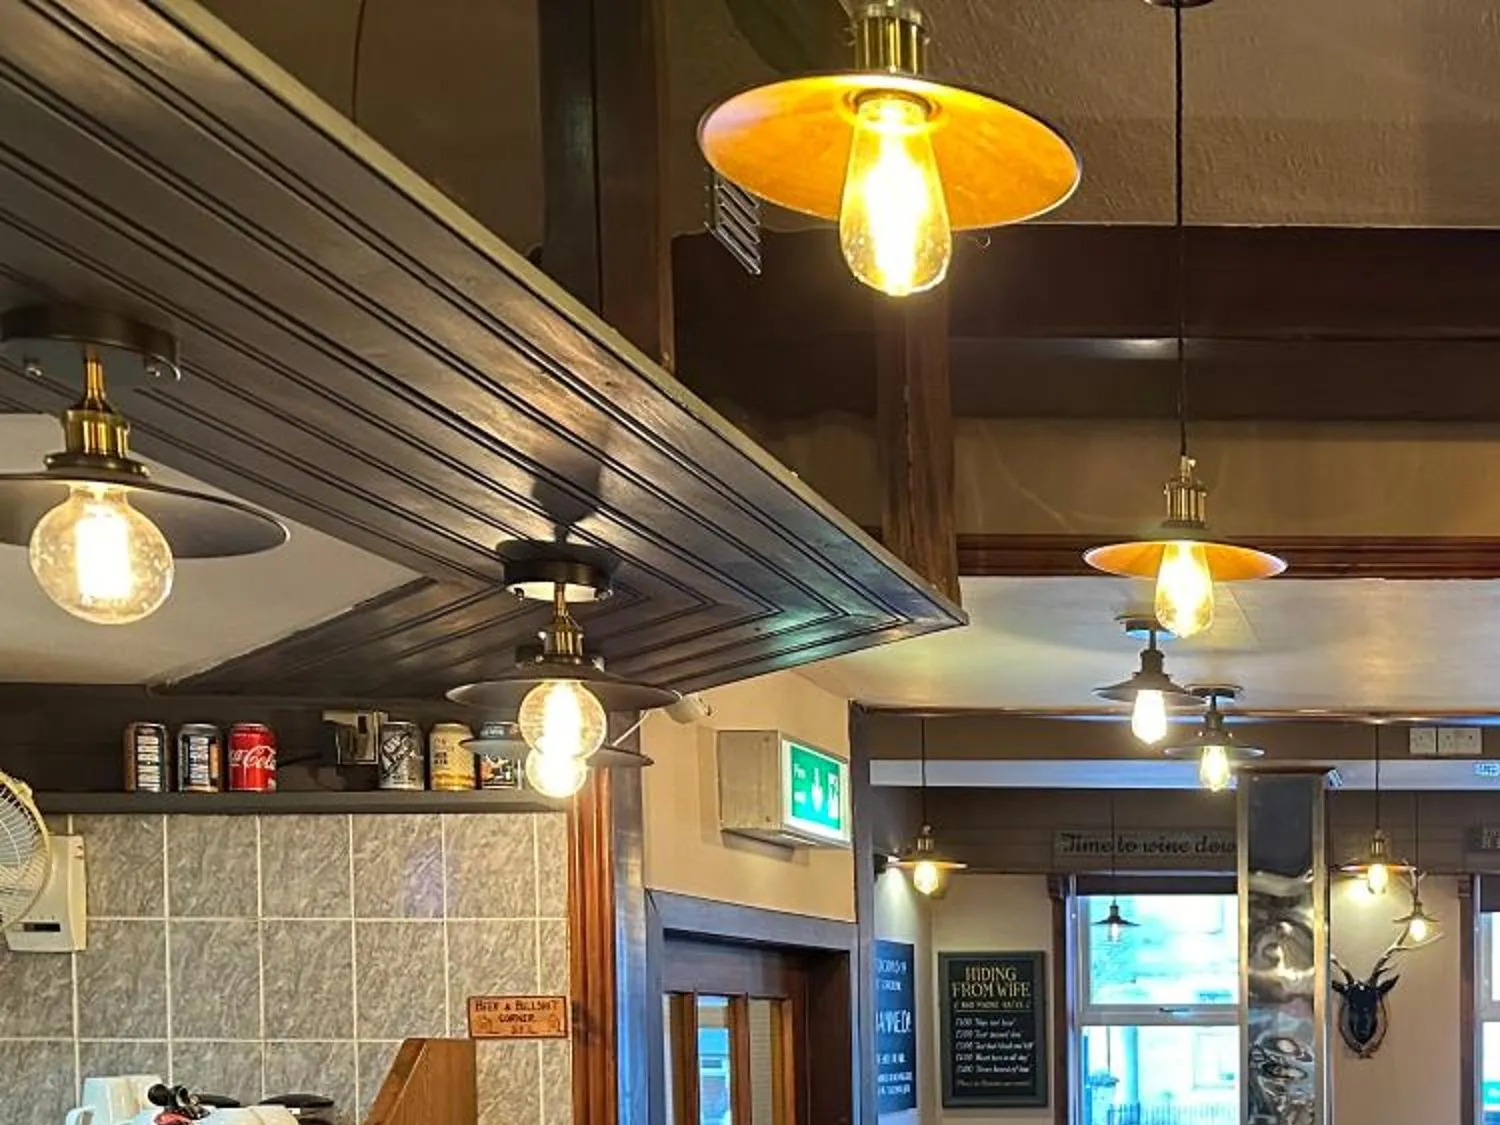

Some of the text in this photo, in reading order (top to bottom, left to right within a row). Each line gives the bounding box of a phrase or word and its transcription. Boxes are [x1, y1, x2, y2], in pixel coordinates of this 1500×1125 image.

[1061, 832, 1112, 853] Time
[1118, 836, 1136, 853] to
[1143, 836, 1190, 853] wine
[965, 966, 1017, 982] HIDING
[952, 981, 1031, 998] FROM WIFE
